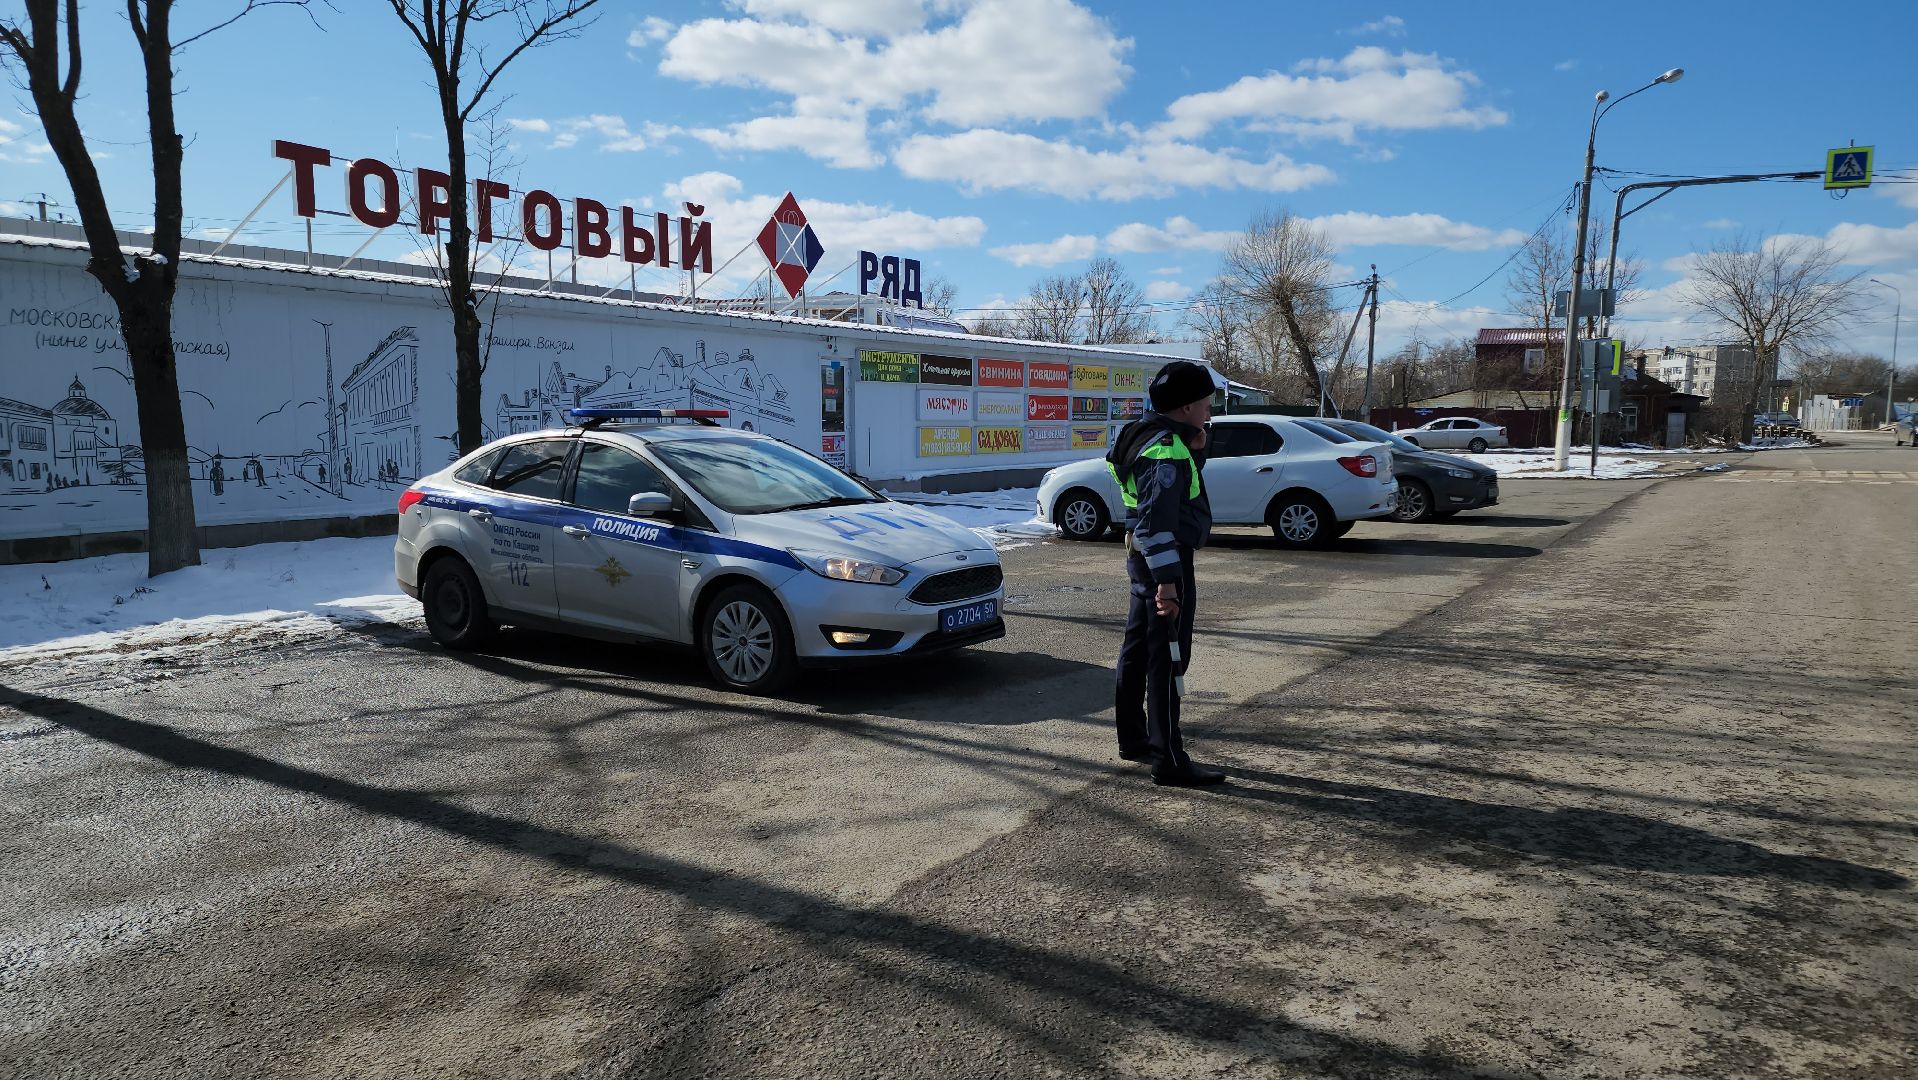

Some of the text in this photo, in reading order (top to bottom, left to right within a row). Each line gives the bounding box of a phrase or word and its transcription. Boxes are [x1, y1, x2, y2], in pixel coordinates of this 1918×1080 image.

[272, 140, 922, 310] ТОРГОВЫЙ РЯД
[9, 308, 121, 330] МОСКОВСК
[860, 350, 919, 366] ИНСТРУМЕНТЫ
[980, 366, 1022, 380] СВИНИНА
[1029, 368, 1068, 382] ГОВЯДИНА
[1114, 372, 1136, 387] ОКНА
[933, 428, 960, 441] АРЕНДА
[977, 430, 1020, 452] САДОВОД
[493, 523, 541, 541] ОМВД России
[592, 517, 660, 541] ПОЛИЦИЯ
[512, 540, 540, 554] Кашира
[508, 561, 530, 587] 112
[957, 605, 981, 625] 2704
[984, 602, 994, 614] 50
